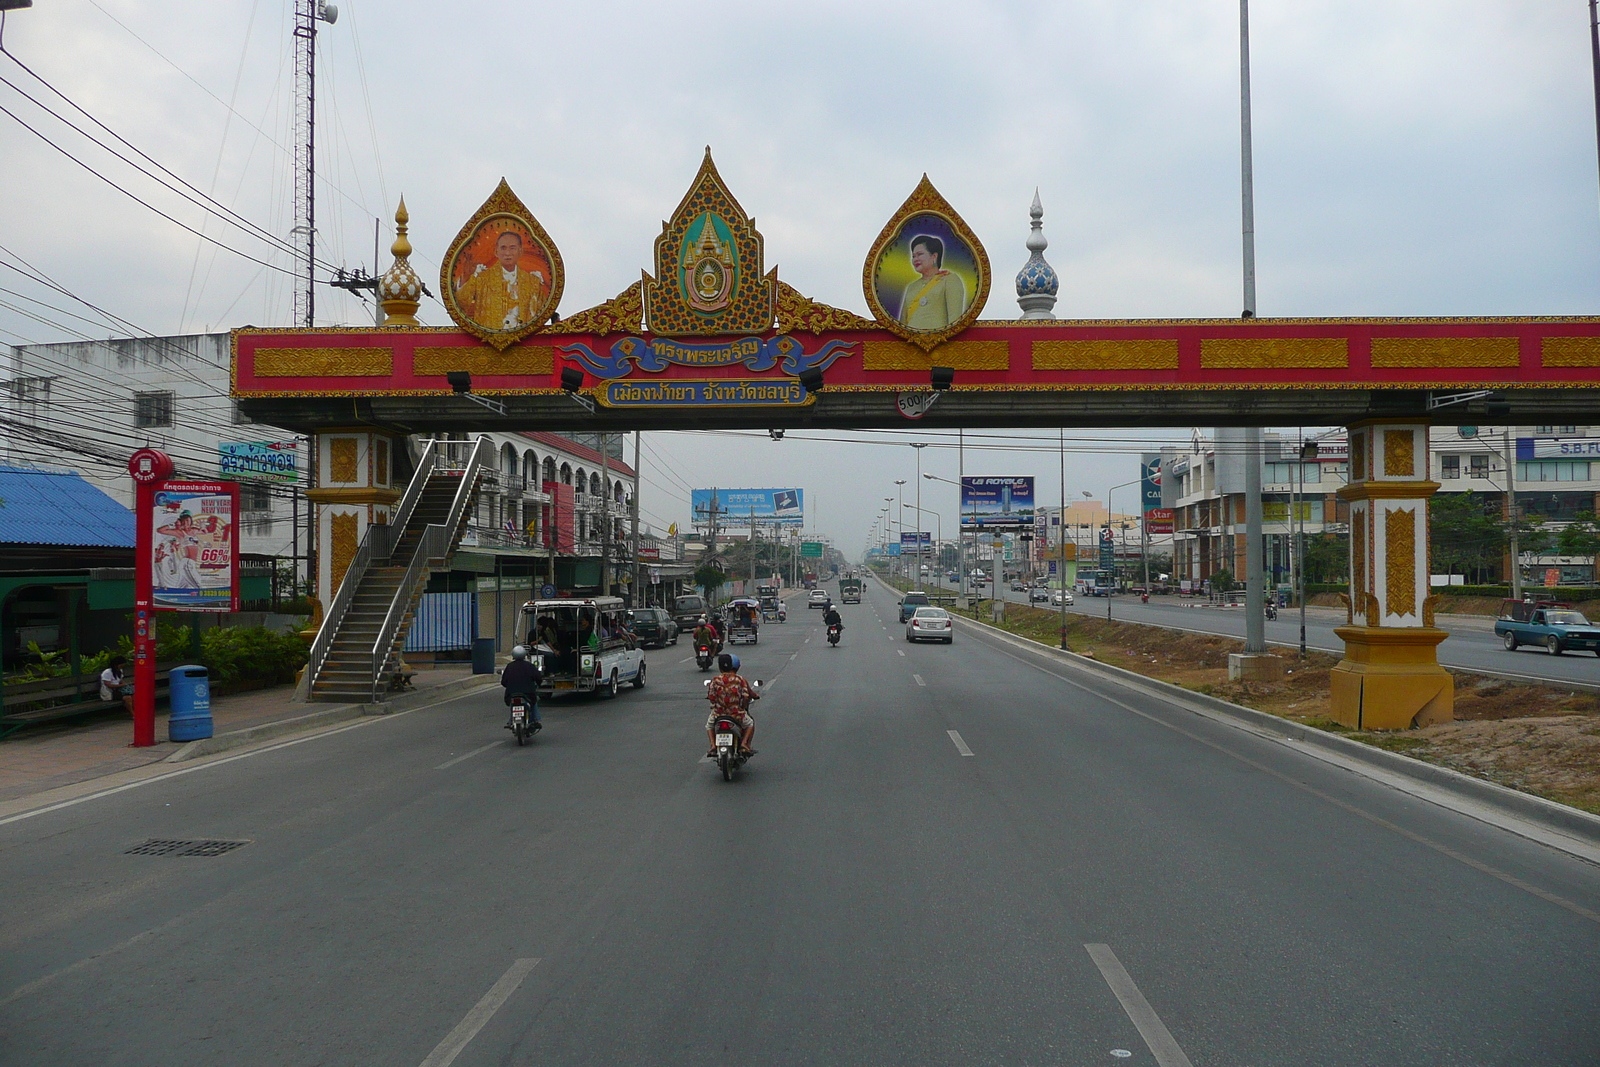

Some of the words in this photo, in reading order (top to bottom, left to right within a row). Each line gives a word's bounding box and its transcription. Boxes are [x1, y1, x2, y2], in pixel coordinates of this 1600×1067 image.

[651, 340, 759, 363] ทรงพระเจริญ
[614, 383, 695, 401] เมืองพัทยา
[702, 381, 801, 403] จังหวัดชลบุรี
[1560, 443, 1586, 454] S.B.
[1152, 508, 1171, 519] Star
[201, 549, 229, 561] 66%
